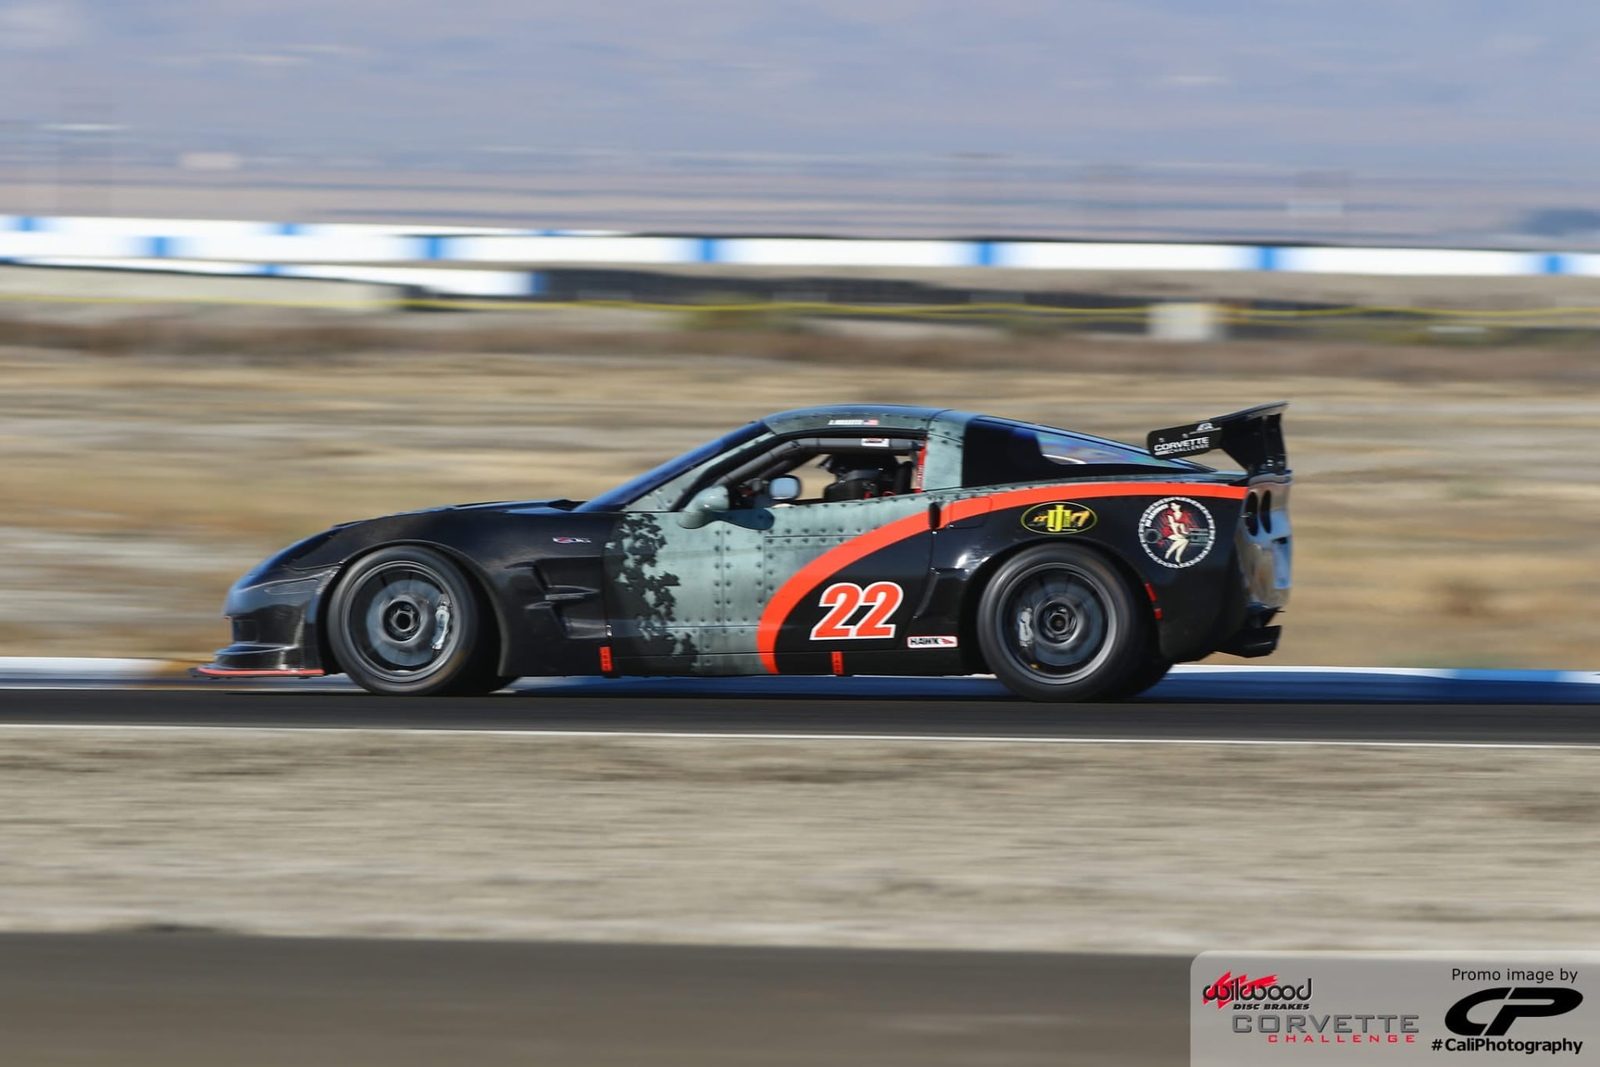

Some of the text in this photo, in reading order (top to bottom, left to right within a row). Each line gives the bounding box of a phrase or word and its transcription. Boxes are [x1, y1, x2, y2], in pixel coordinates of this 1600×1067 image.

[1154, 436, 1210, 452] CORVETTE
[809, 581, 904, 640] 22
[910, 637, 939, 646] HAWK
